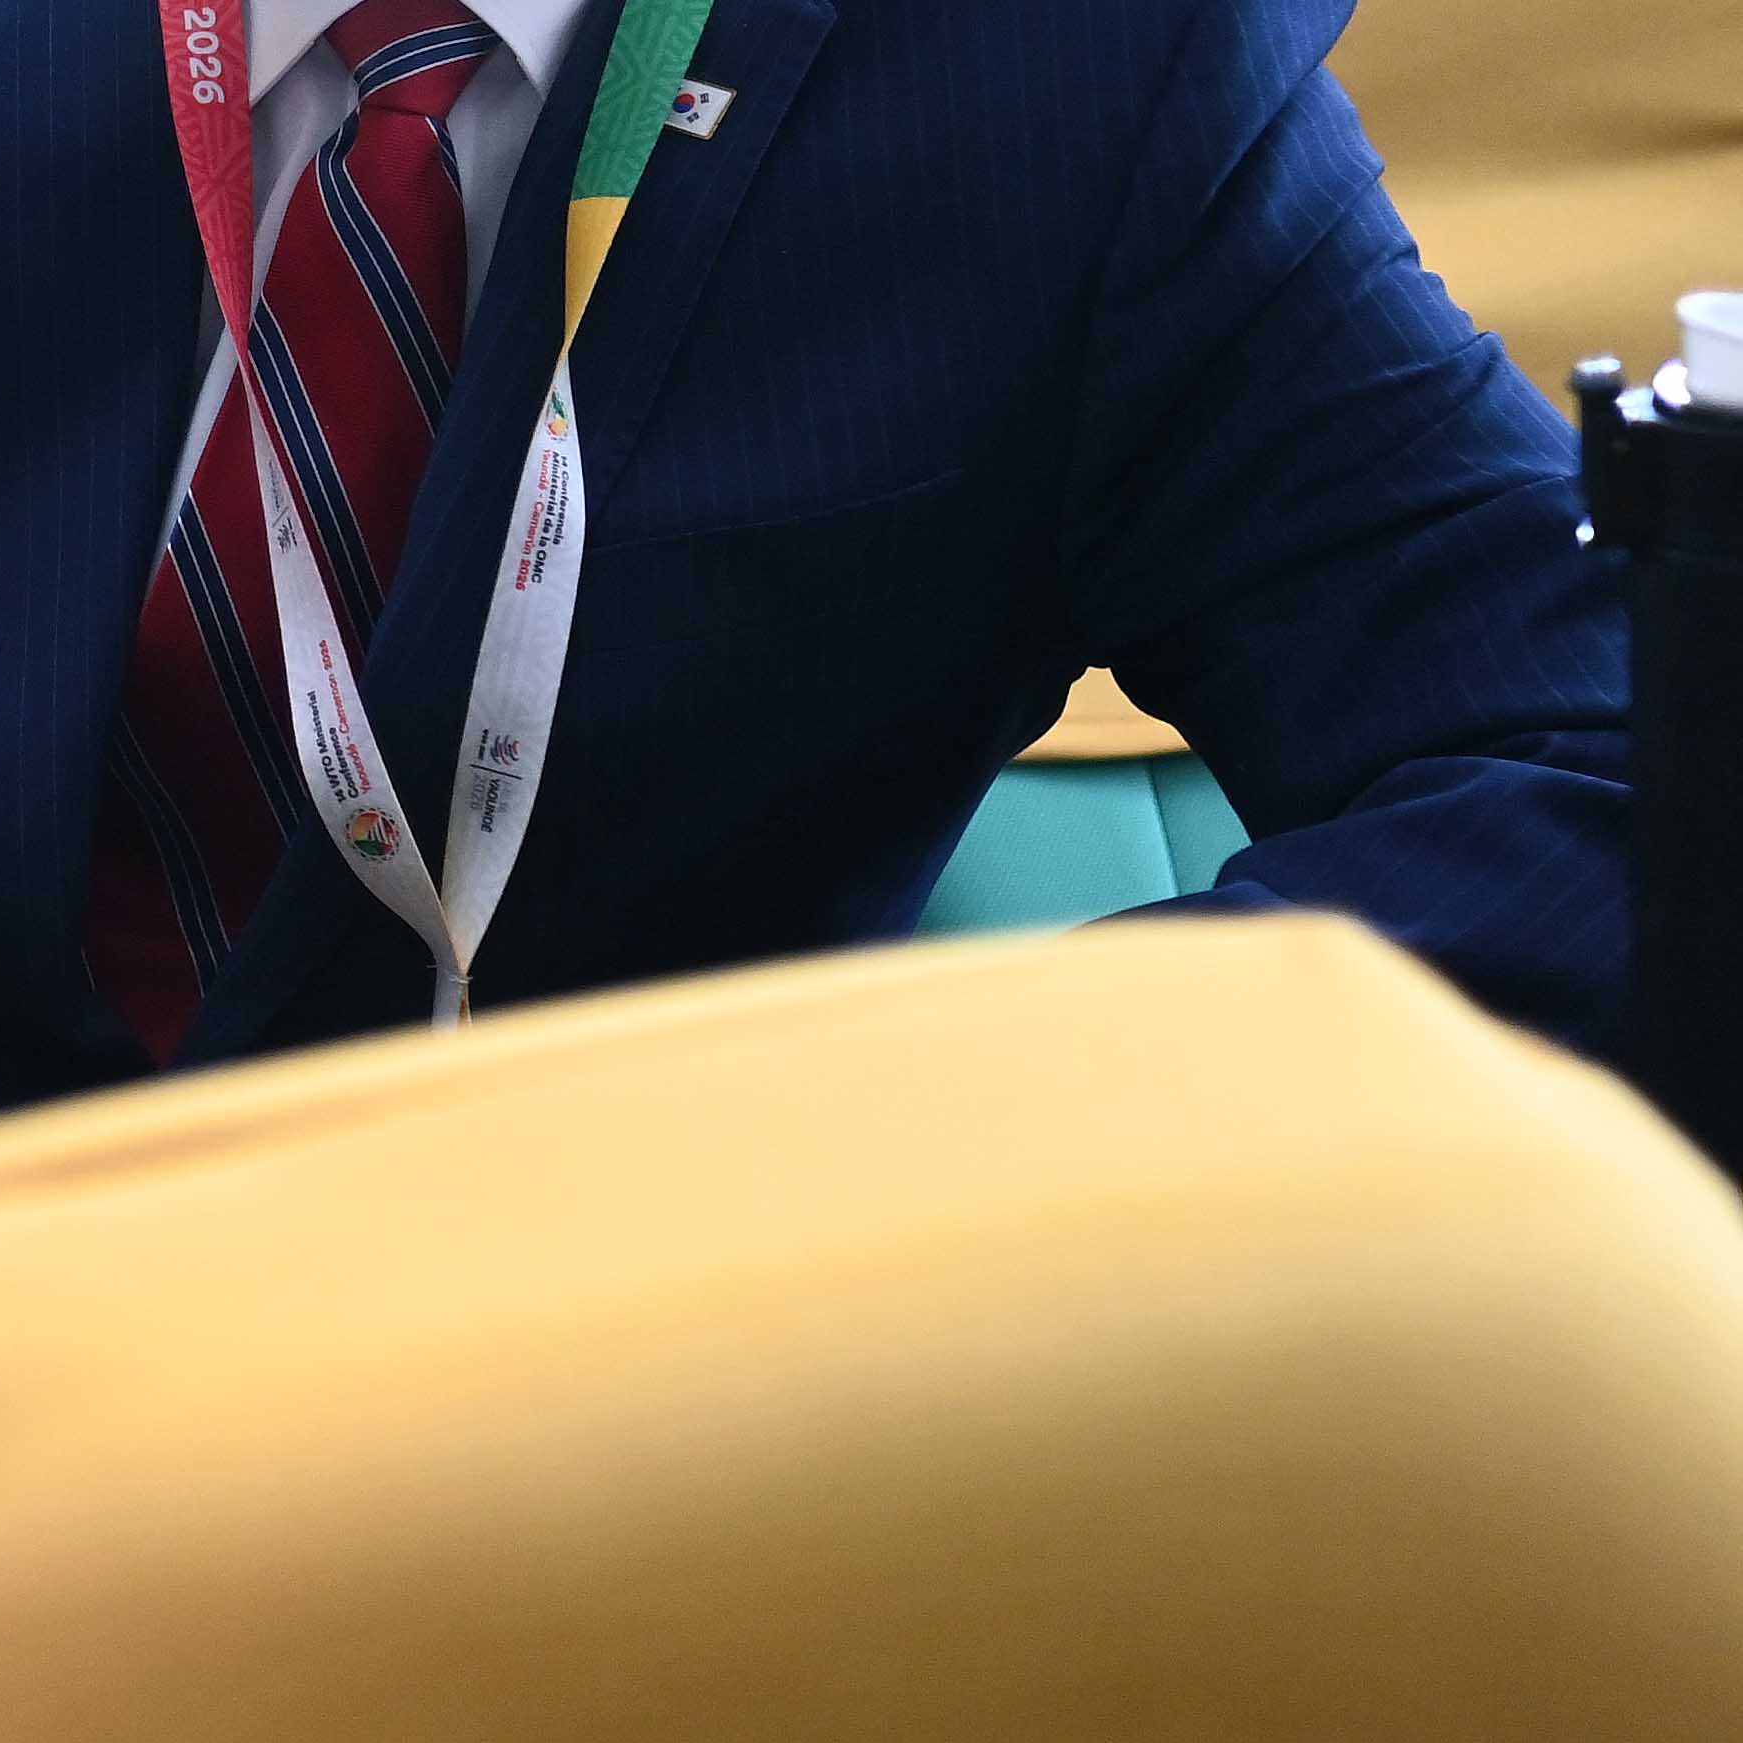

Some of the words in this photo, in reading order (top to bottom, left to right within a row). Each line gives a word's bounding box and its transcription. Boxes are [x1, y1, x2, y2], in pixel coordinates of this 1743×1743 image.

[183, 6, 226, 104] 2026
[545, 451, 560, 517] Ministerial
[552, 471, 570, 545] Conferencia
[540, 534, 551, 547] la
[542, 516, 554, 534] de
[515, 559, 531, 591] 2026
[531, 549, 547, 584] OMC
[307, 690, 329, 754] Ministerial
[328, 673, 350, 734] Cameroon
[321, 755, 341, 789] WTO
[329, 727, 359, 799] Conference
